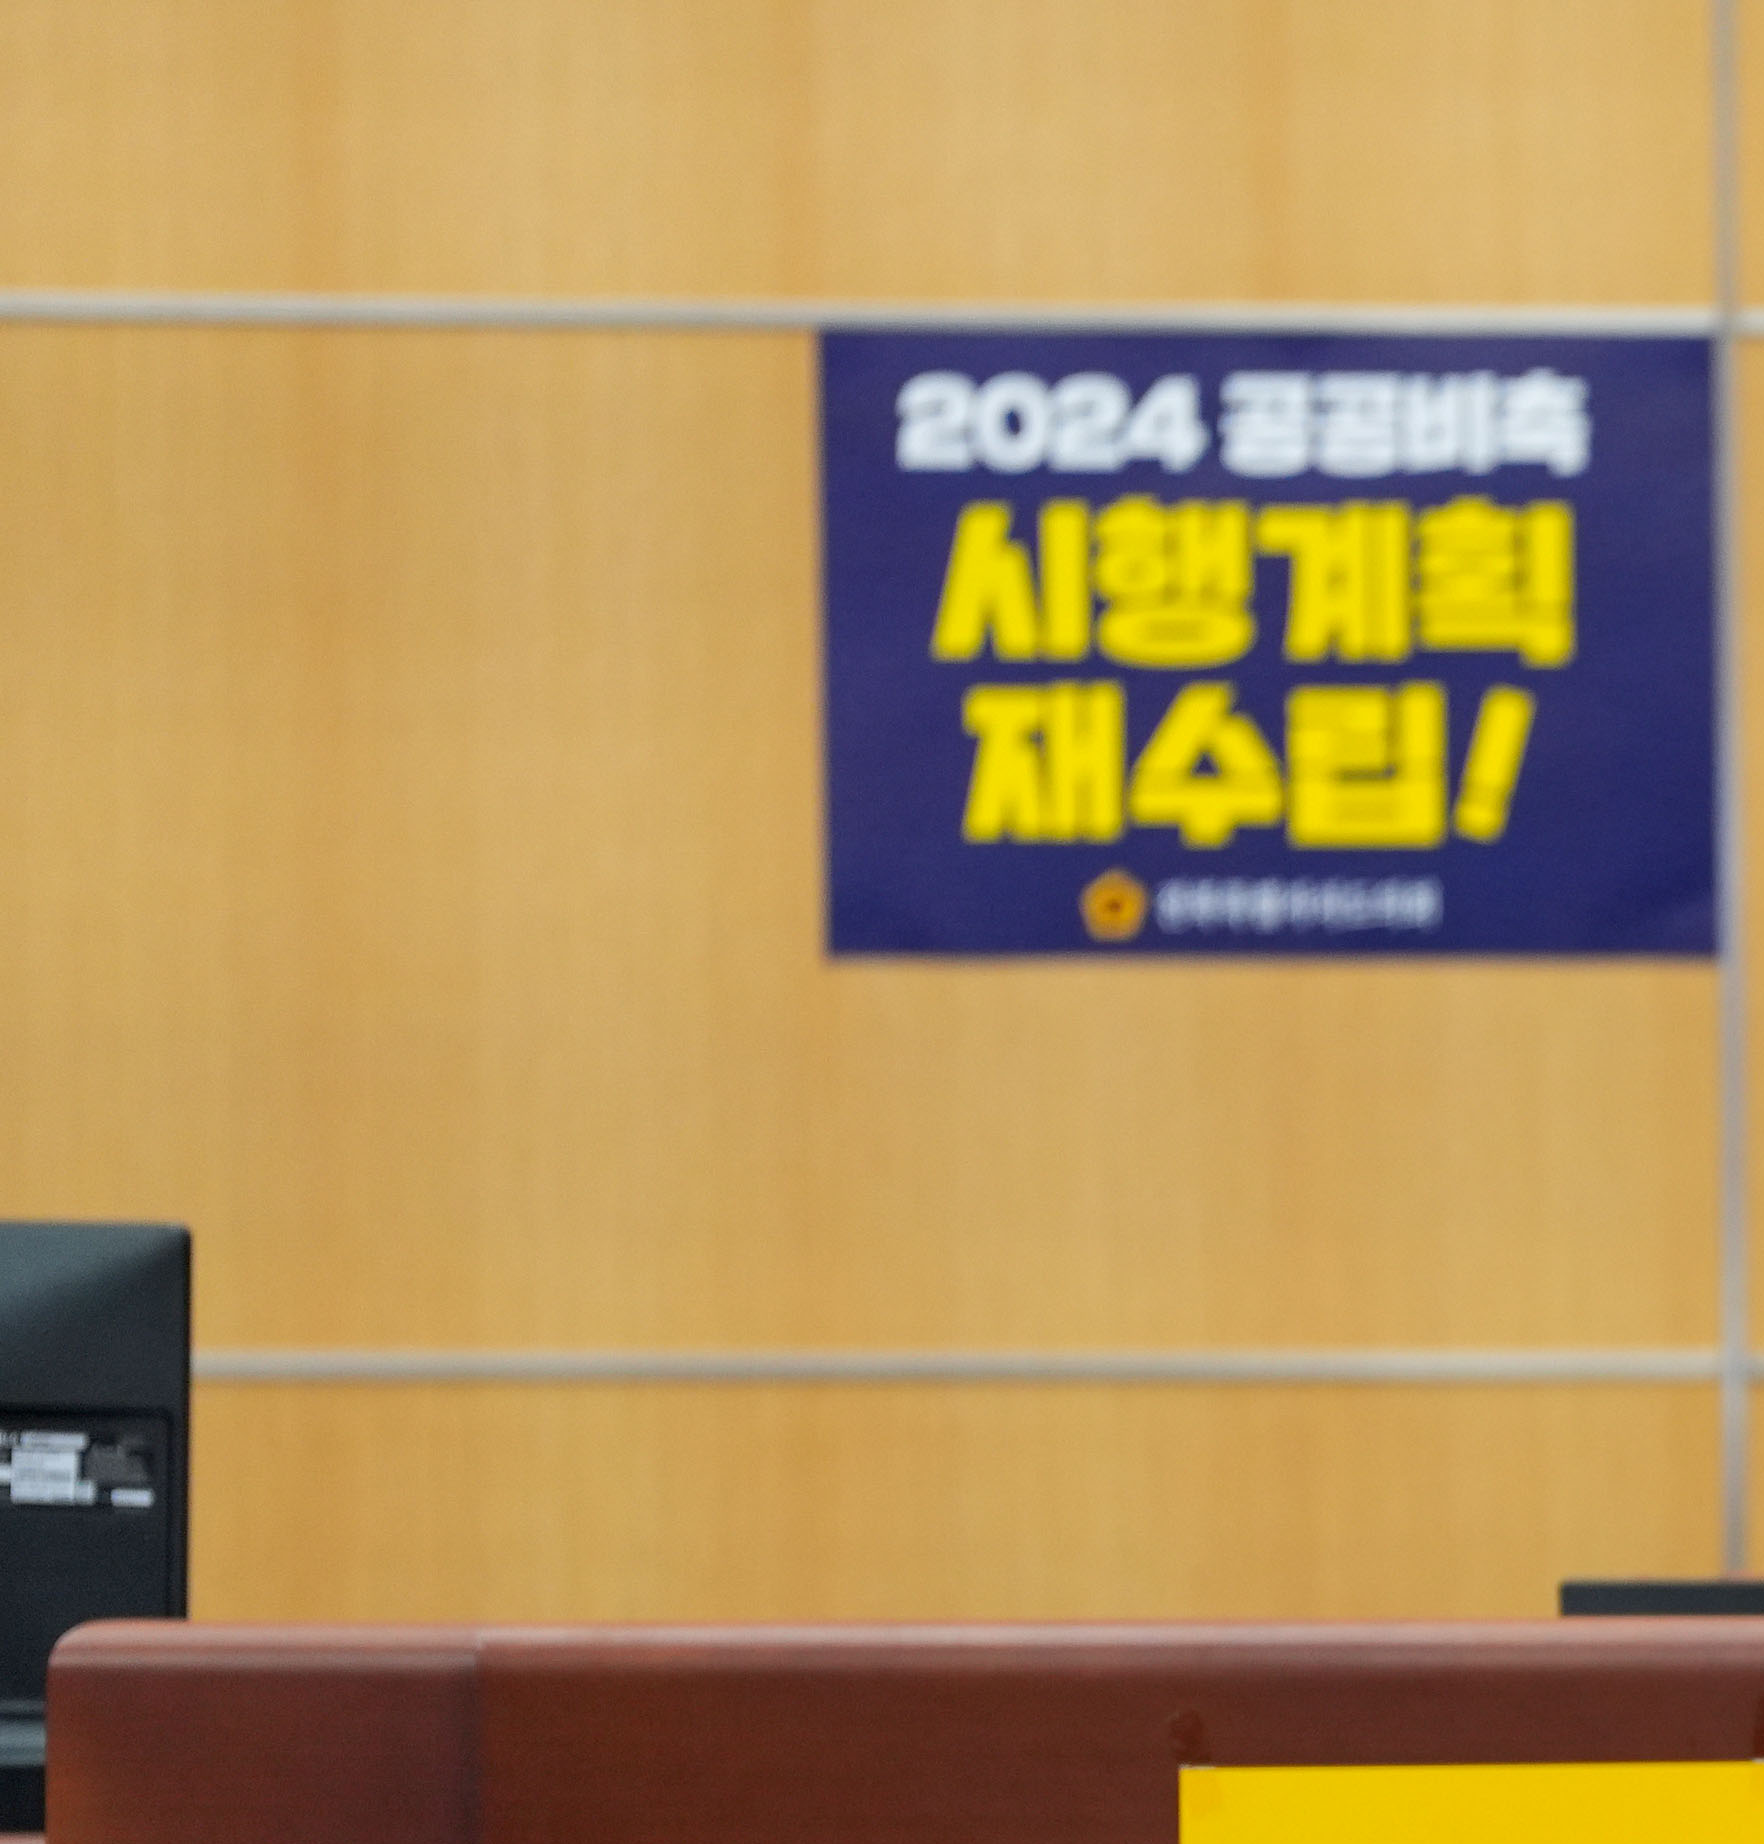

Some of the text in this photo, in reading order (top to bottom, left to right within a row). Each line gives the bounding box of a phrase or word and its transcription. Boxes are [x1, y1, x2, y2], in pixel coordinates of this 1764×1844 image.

[899, 375, 1204, 469] 2024
[936, 499, 1572, 666] 시행계획
[966, 684, 1530, 845] 재수립!
